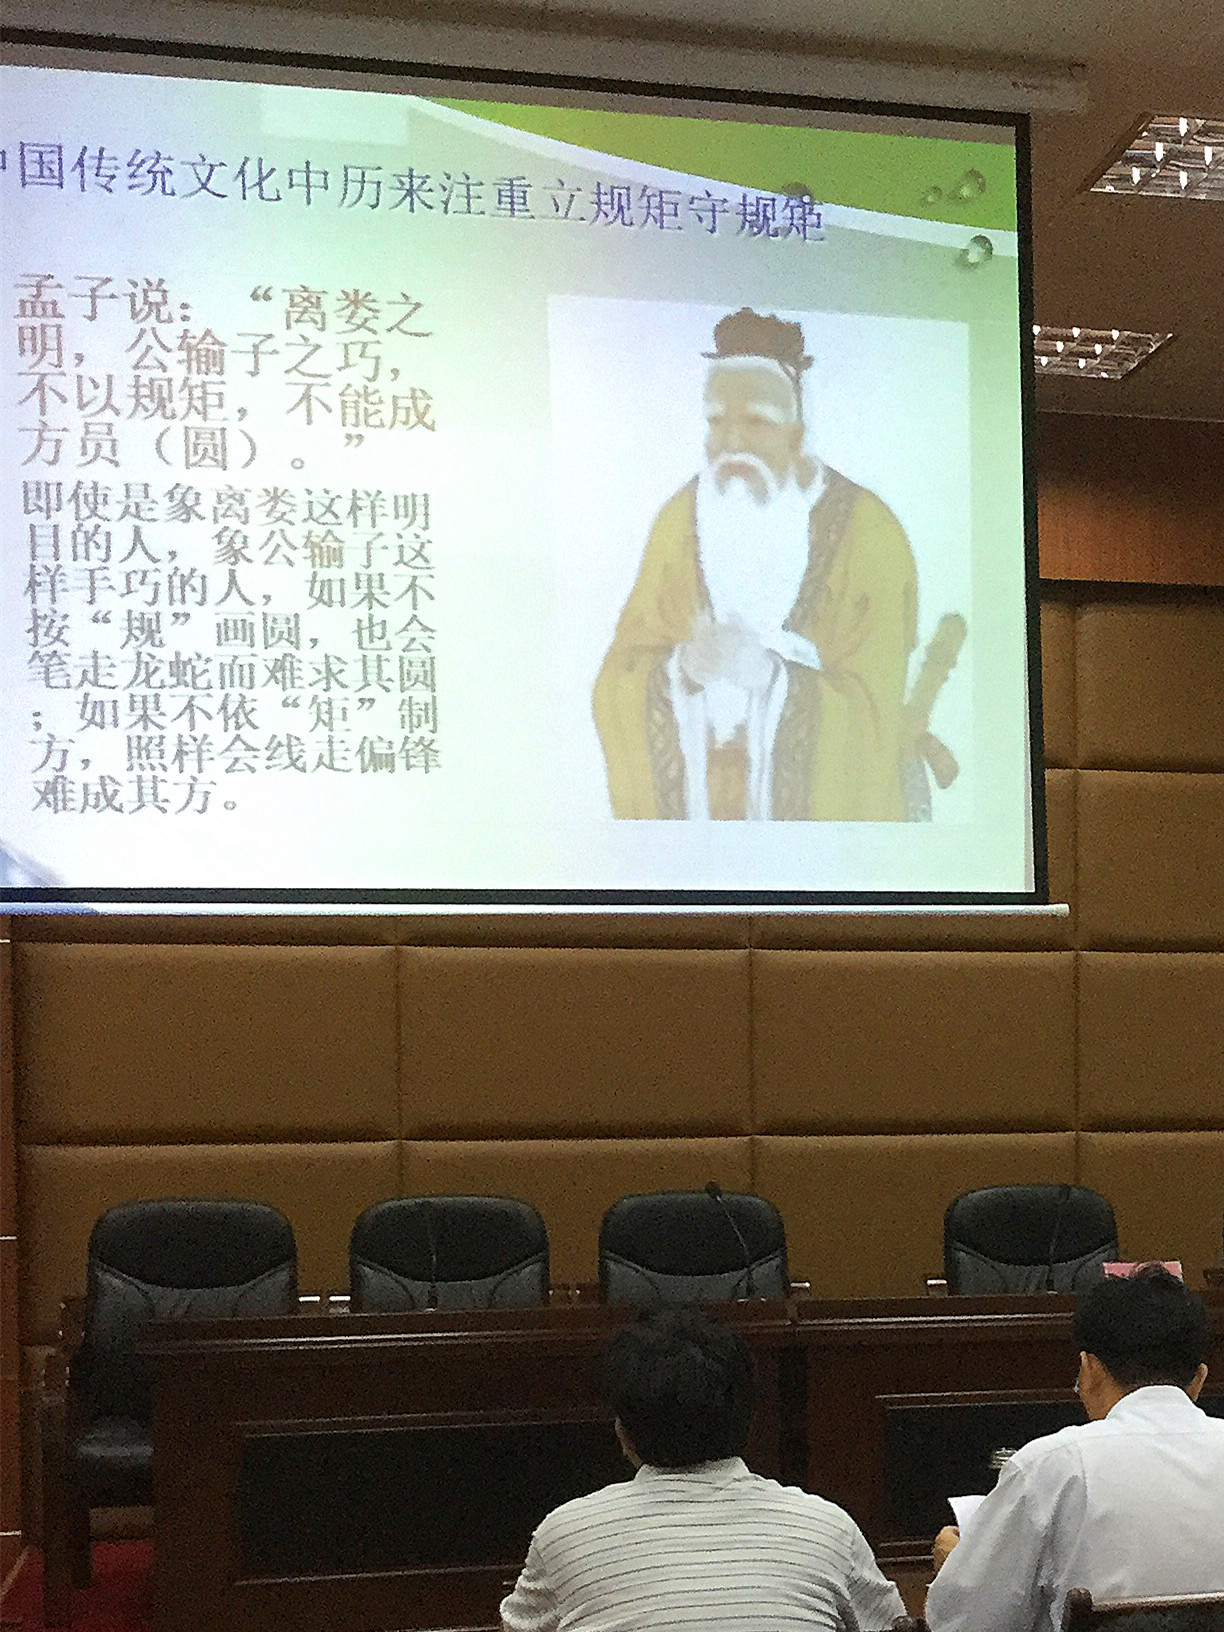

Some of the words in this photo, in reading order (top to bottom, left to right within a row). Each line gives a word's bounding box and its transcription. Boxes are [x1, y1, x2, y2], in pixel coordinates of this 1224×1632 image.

[0, 141, 826, 242] 国传统文化中历来注重立规矩守规矩
[18, 372, 436, 432] 不以规矩，不能成
[22, 563, 436, 611] 样手巧的人，如果不
[28, 650, 437, 693] 笔走龙蛇而难求其圆
[30, 733, 441, 774] 方，照样会线走偏锋
[32, 774, 237, 815] 难成其方。
